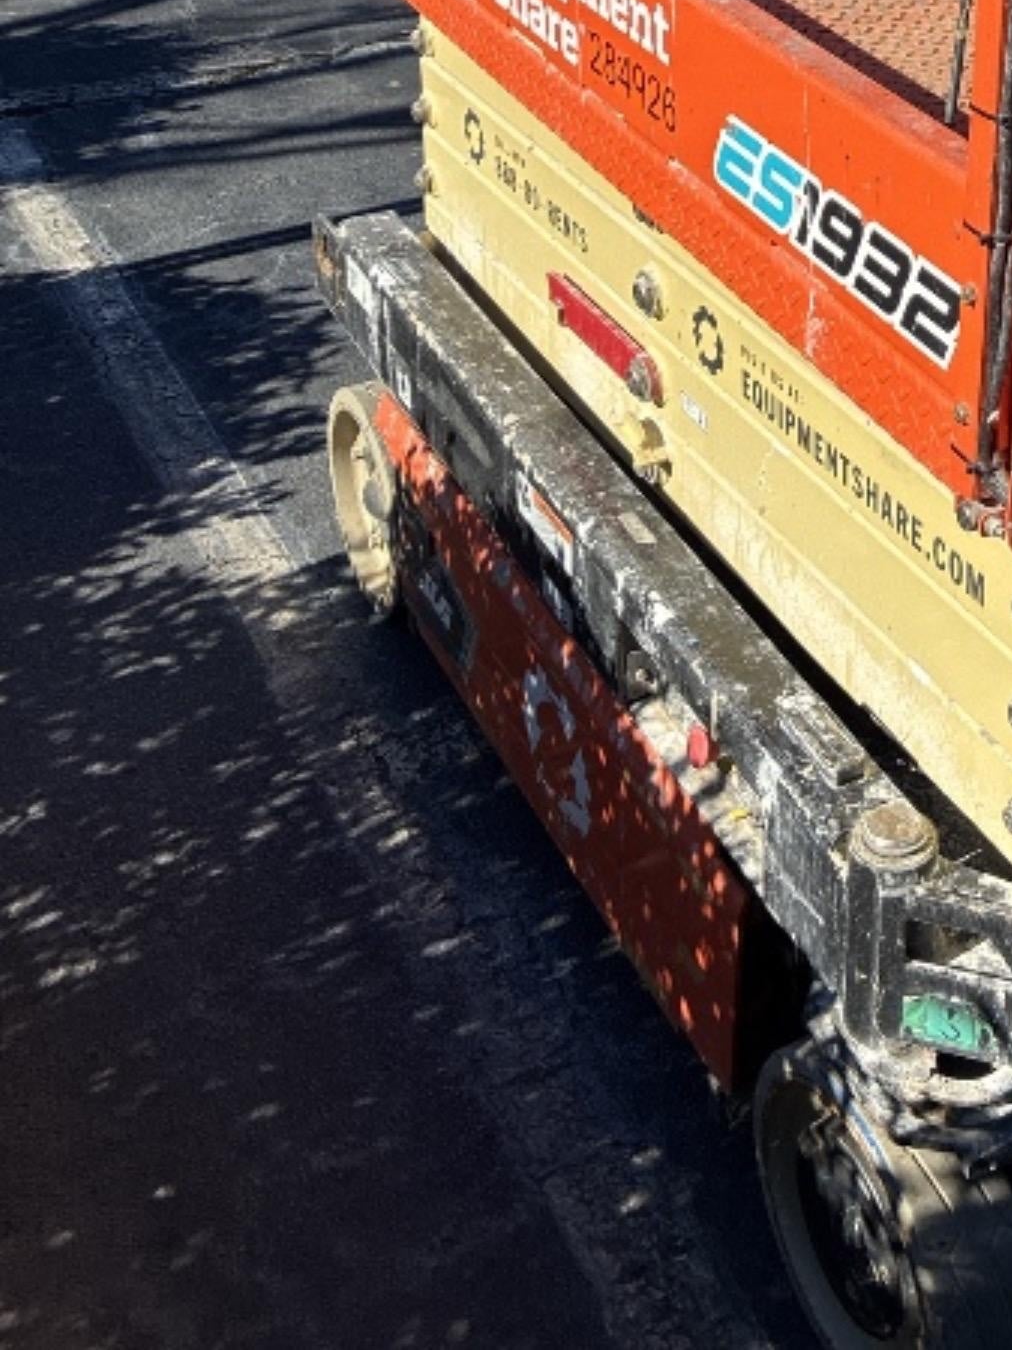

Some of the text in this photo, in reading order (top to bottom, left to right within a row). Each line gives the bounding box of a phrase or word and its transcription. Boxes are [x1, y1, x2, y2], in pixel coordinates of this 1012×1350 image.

[589, 31, 676, 133] 284926
[714, 114, 963, 368] ES1932
[741, 369, 986, 608] EQUIPMENTSHARE.COM
